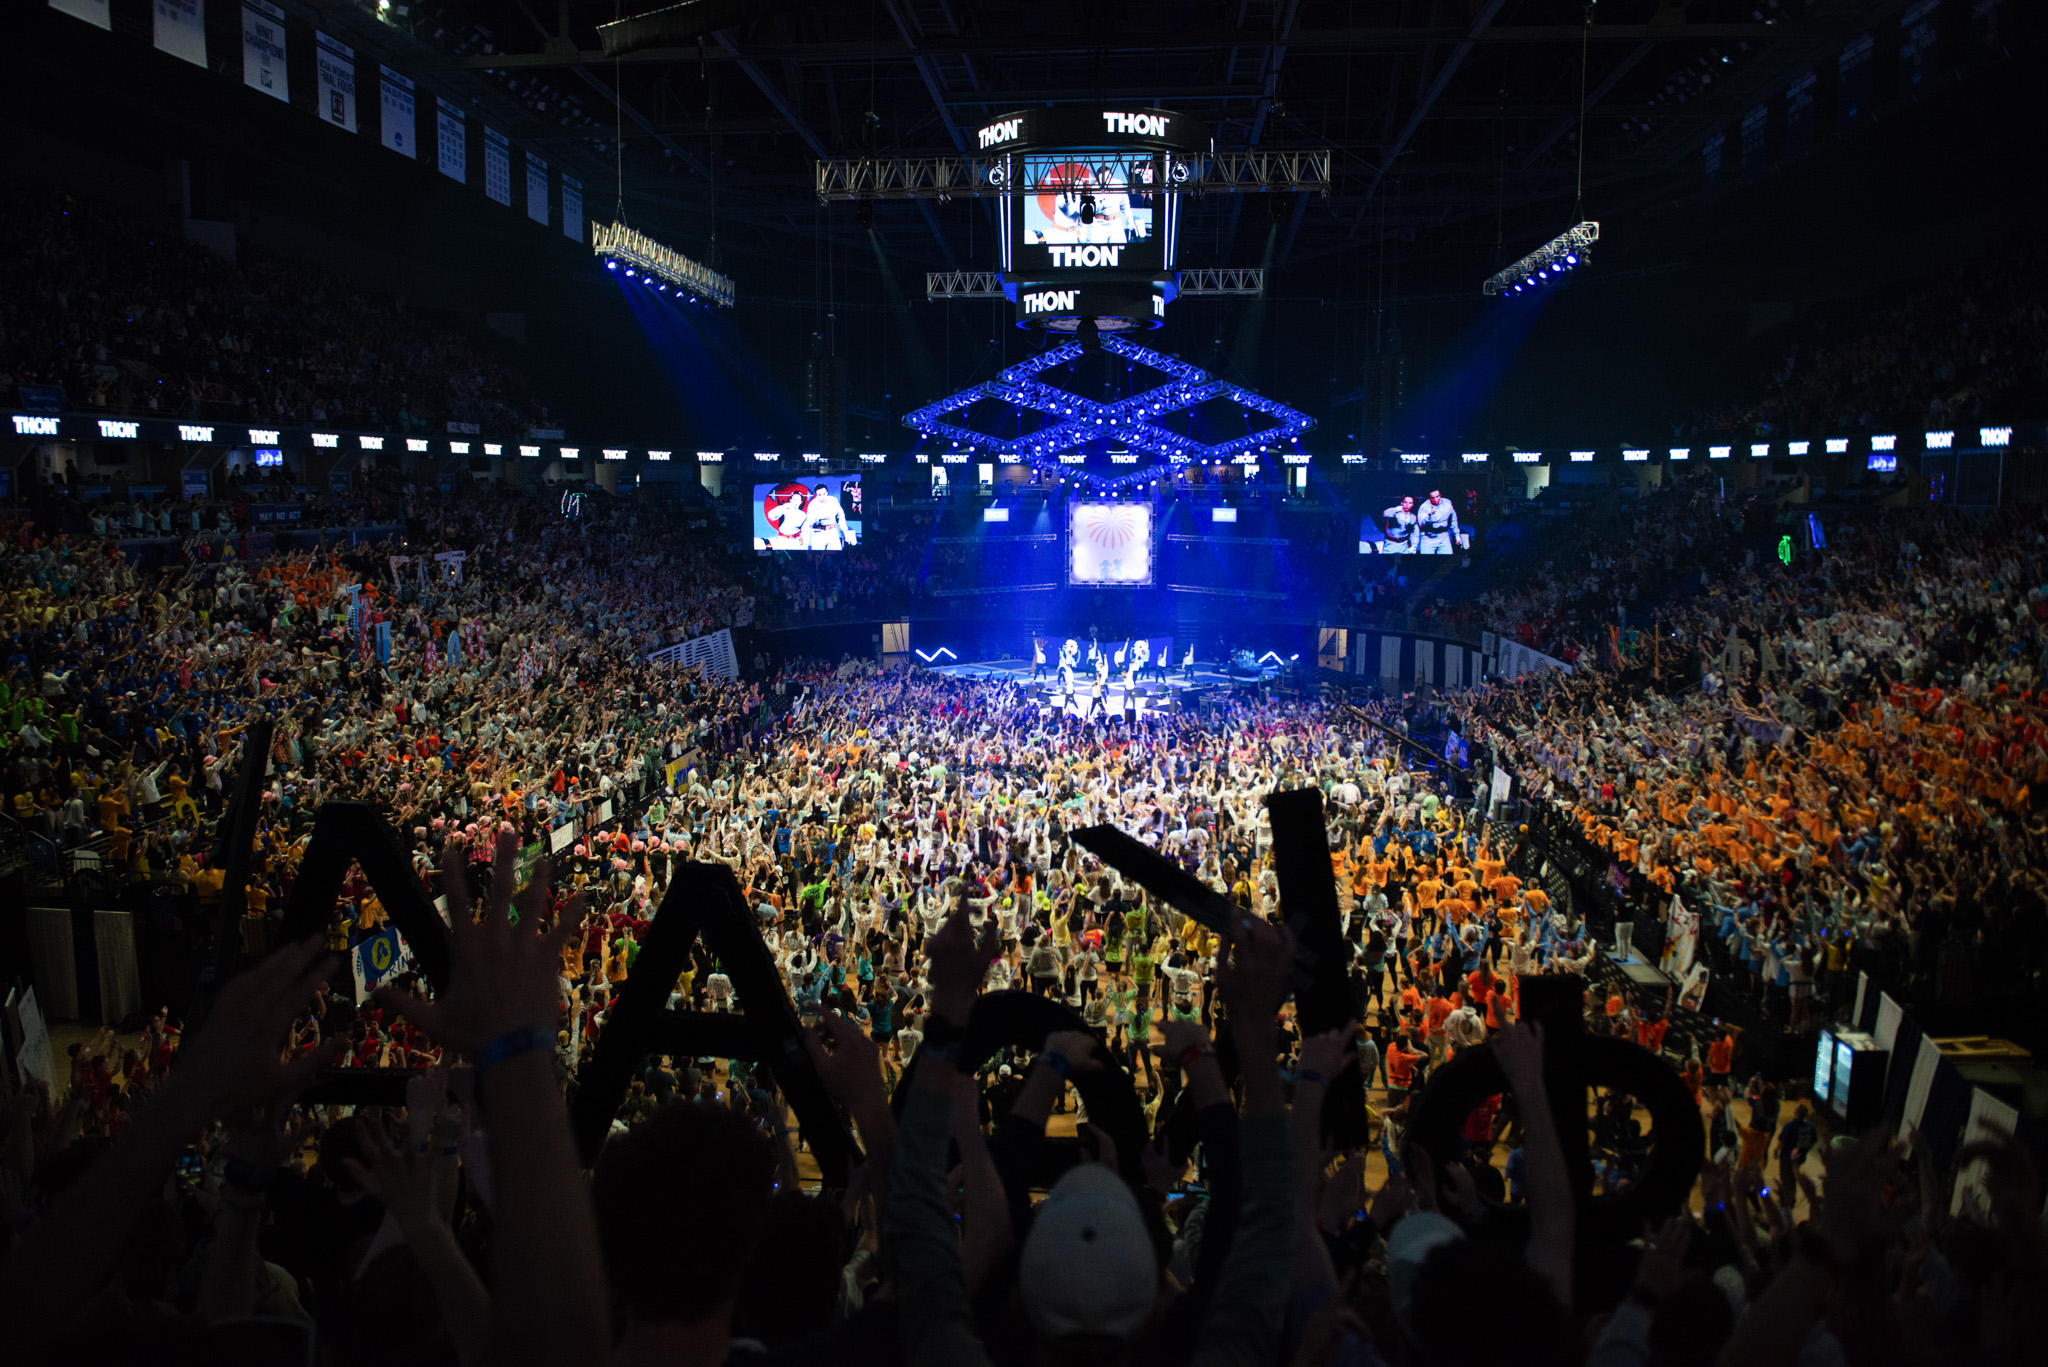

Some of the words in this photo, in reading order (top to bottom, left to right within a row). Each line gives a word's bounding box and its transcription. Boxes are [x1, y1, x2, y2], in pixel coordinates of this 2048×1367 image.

[245, 30, 285, 60] CHAMPIONS
[1103, 111, 1169, 137] THON
[978, 118, 1022, 149] THON
[1048, 245, 1125, 267] THON
[1024, 290, 1080, 314] THON
[12, 415, 60, 435] THON
[97, 420, 140, 439] THON
[178, 425, 215, 442] THON
[248, 429, 280, 445] THON
[311, 433, 339, 448] THON
[1925, 431, 1955, 449] THON
[1980, 427, 2013, 446] THON
[359, 436, 384, 450] THON
[406, 439, 429, 452] THON
[1825, 438, 1849, 453] THON
[1871, 435, 1897, 451] THON
[941, 454, 969, 463] THON
[1059, 454, 1086, 463] THON
[1111, 454, 1138, 463] THON
[1283, 454, 1312, 463] THON
[1512, 452, 1542, 463] THON
[1569, 451, 1596, 462] THON
[259, 512, 273, 521] MAY
[276, 512, 286, 521] NO
[289, 511, 302, 520] ACT
